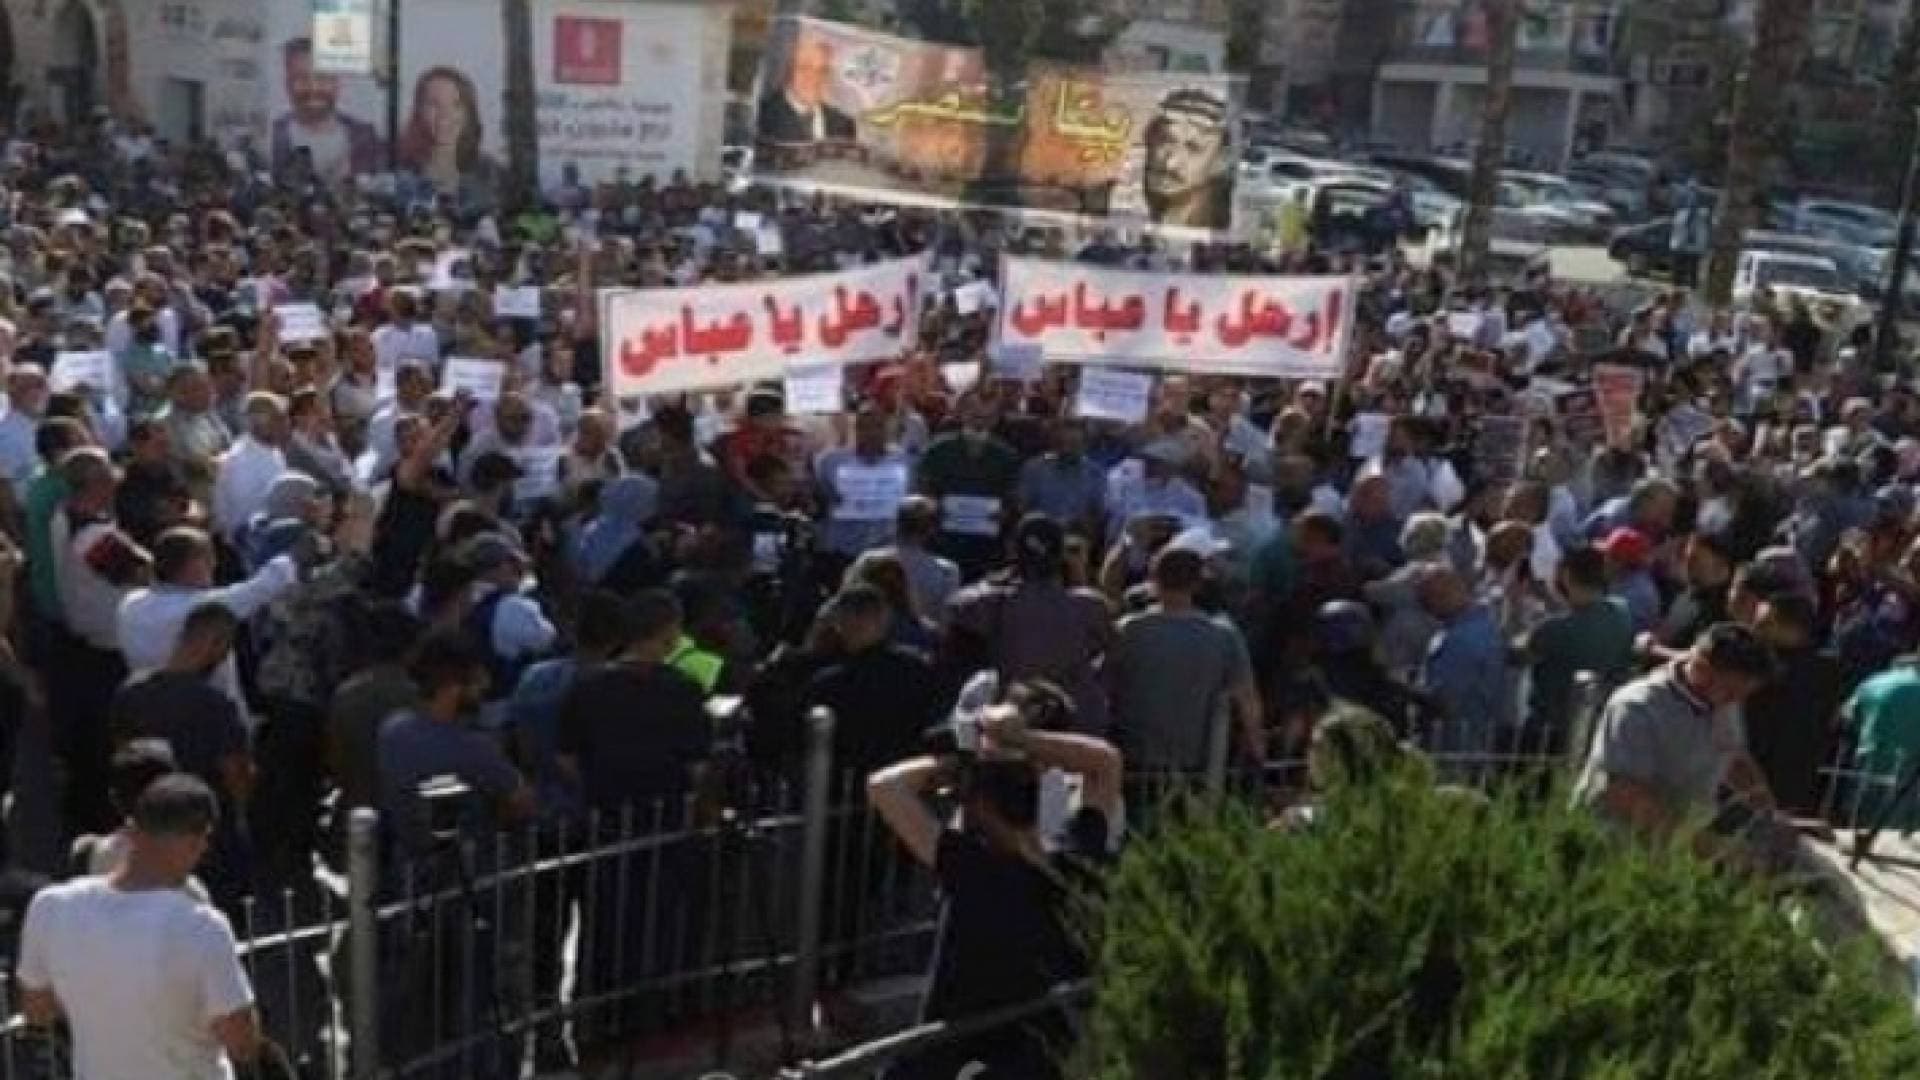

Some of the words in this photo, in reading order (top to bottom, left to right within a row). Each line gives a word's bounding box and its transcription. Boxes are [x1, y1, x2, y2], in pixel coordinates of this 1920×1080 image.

[764, 295, 803, 353] يا
[1011, 281, 1146, 337] عباس
[1163, 286, 1202, 345] يا
[620, 303, 751, 377] عباس
